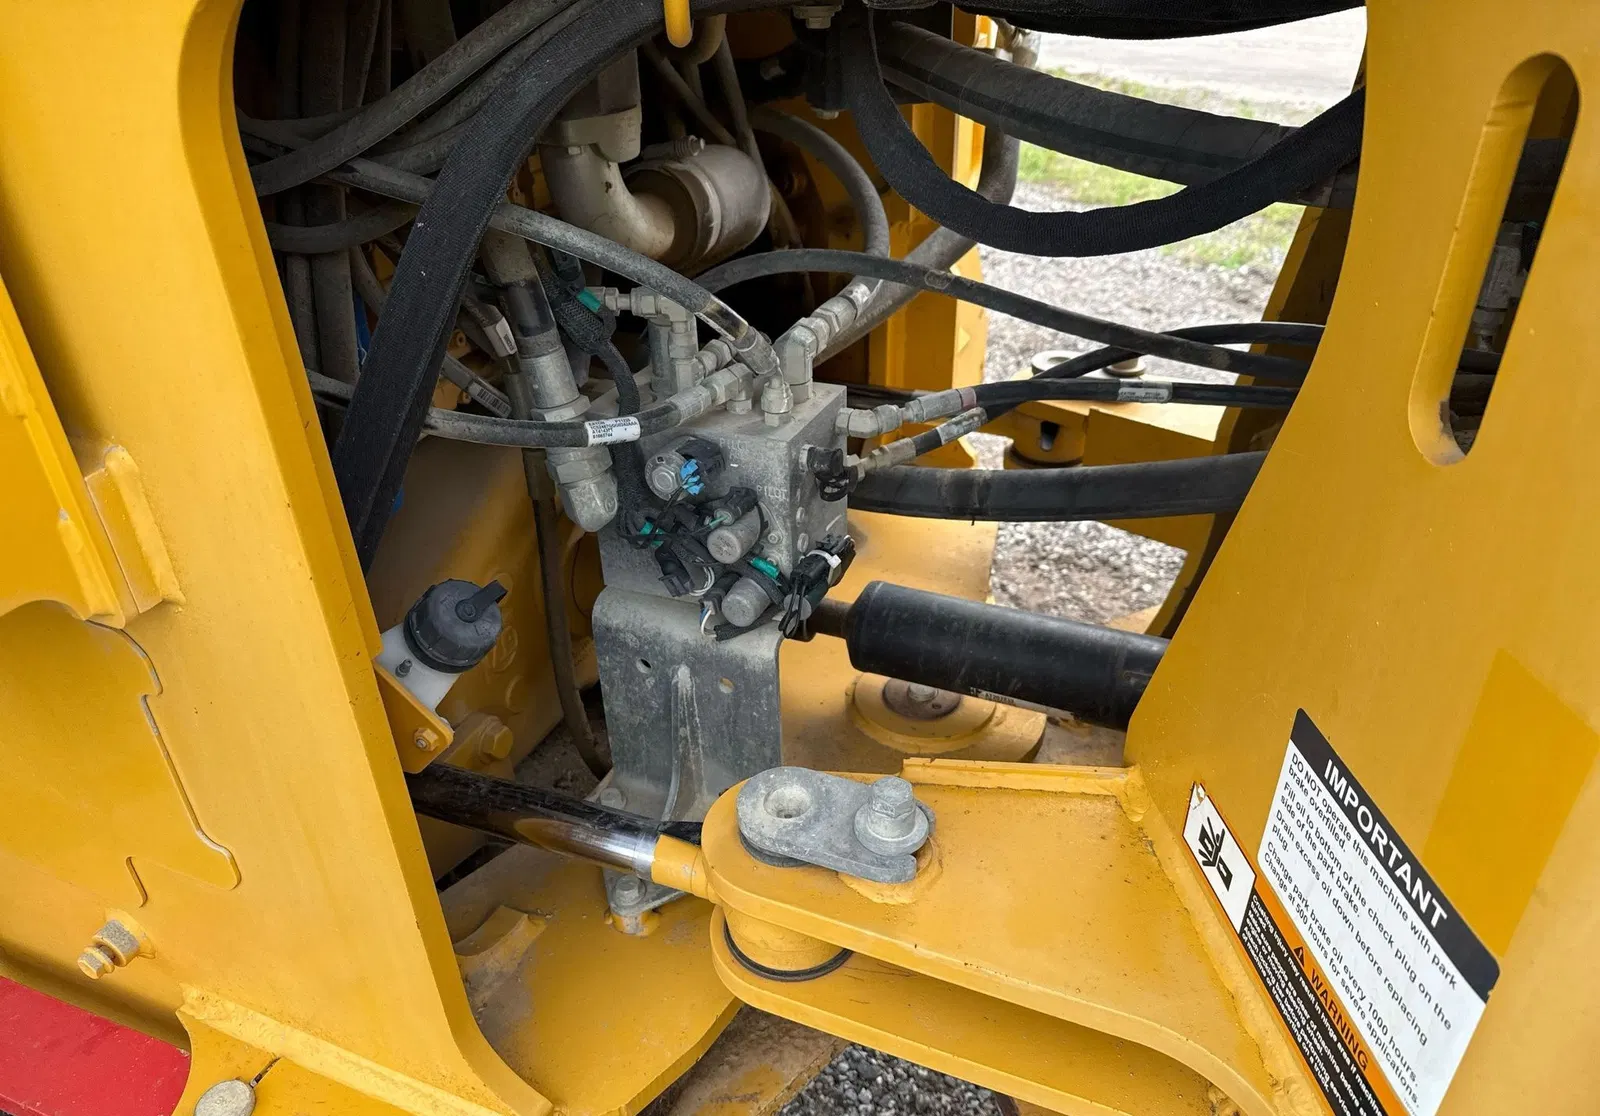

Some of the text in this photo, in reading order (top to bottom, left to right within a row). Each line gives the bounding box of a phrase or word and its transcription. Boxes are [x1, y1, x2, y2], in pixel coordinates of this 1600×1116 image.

[1271, 824, 1288, 852] plug.
[1280, 795, 1359, 917] side of the park brake.
[1283, 781, 1450, 1029] Fill oil to bottom of the check plug on the
[1288, 763, 1345, 852] brake overfilled.
[1291, 752, 1456, 988] DO NOT operate this machine with park
[1324, 759, 1447, 927] IMPORTANT
[1264, 852, 1287, 892] Change
[1287, 892, 1295, 905] at
[1295, 902, 1308, 924] 500
[1307, 923, 1328, 958] hours
[1328, 957, 1340, 976] for
[1340, 977, 1365, 1019] severe
[1366, 1021, 1418, 1107] applications.
[1267, 841, 1292, 884] Change
[1292, 884, 1309, 911] park
[1309, 909, 1330, 945] brake
[1332, 946, 1343, 963] oil
[1343, 964, 1366, 1000] every
[1368, 1002, 1388, 1035] 1000
[1388, 1035, 1417, 1086] hours.
[1275, 809, 1427, 1045] Drain excess oil down before replacing
[1311, 969, 1369, 1071] WARNING
